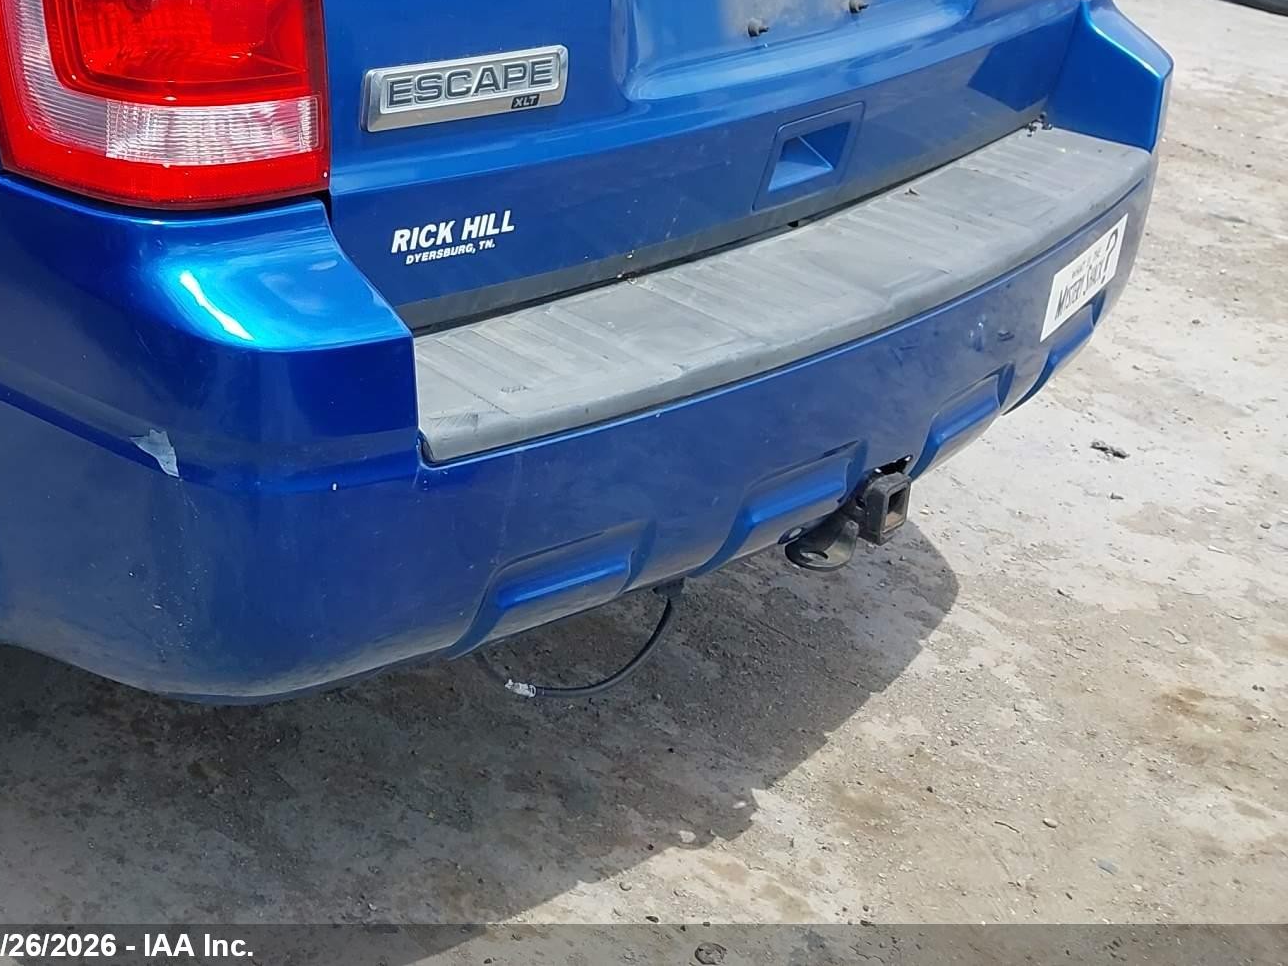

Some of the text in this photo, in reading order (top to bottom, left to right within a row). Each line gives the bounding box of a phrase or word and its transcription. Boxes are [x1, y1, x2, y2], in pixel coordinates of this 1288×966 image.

[388, 59, 553, 109] ESCAPE
[514, 95, 538, 108] XLT
[391, 210, 515, 253] RICK HILL
[405, 238, 496, 265] DYERSBURG, TN.
